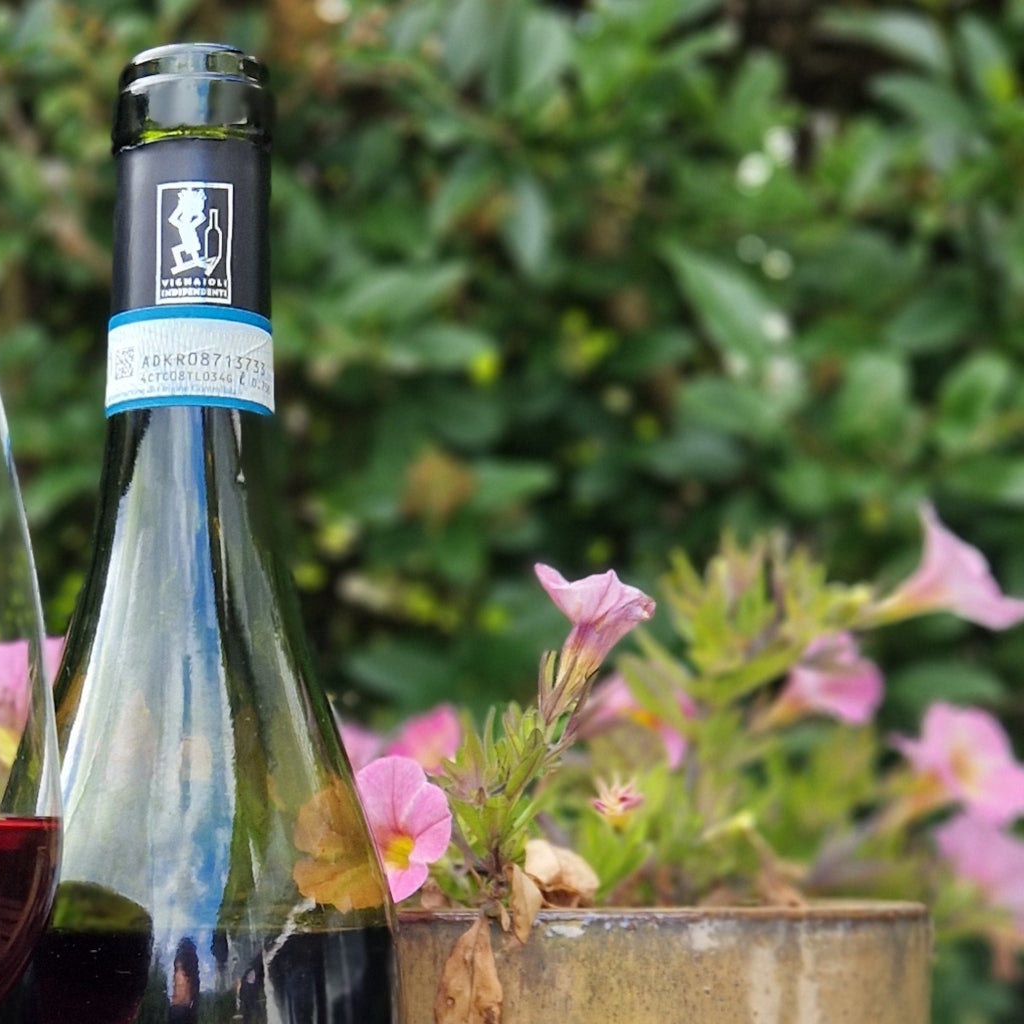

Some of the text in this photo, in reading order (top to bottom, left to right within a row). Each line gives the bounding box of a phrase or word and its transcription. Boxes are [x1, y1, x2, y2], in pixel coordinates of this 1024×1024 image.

[161, 277, 228, 288] VIGNAIOLI
[161, 287, 228, 298] INDIPENDENTI
[141, 352, 266, 376] ADKR08713733
